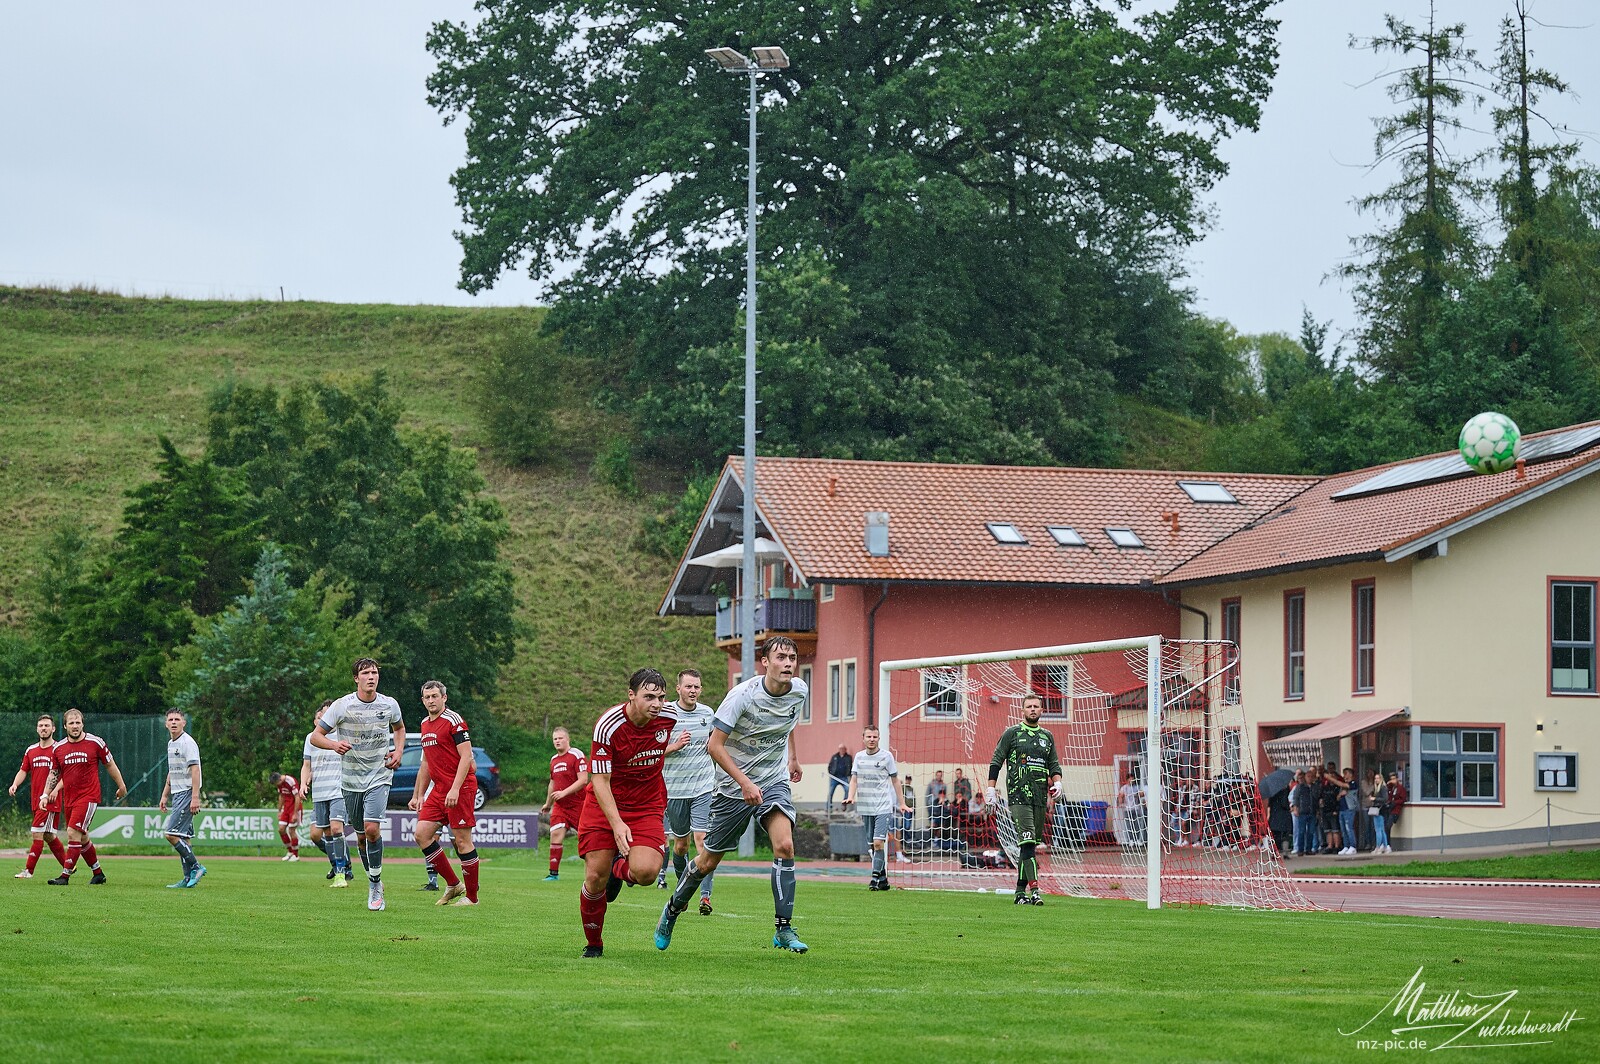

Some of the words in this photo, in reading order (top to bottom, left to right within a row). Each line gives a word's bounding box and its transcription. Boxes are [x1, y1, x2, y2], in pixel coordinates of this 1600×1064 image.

[200, 815, 274, 831] AICHER
[471, 818, 527, 834] CHER
[197, 830, 207, 840] &
[210, 830, 275, 840] RECYCLING
